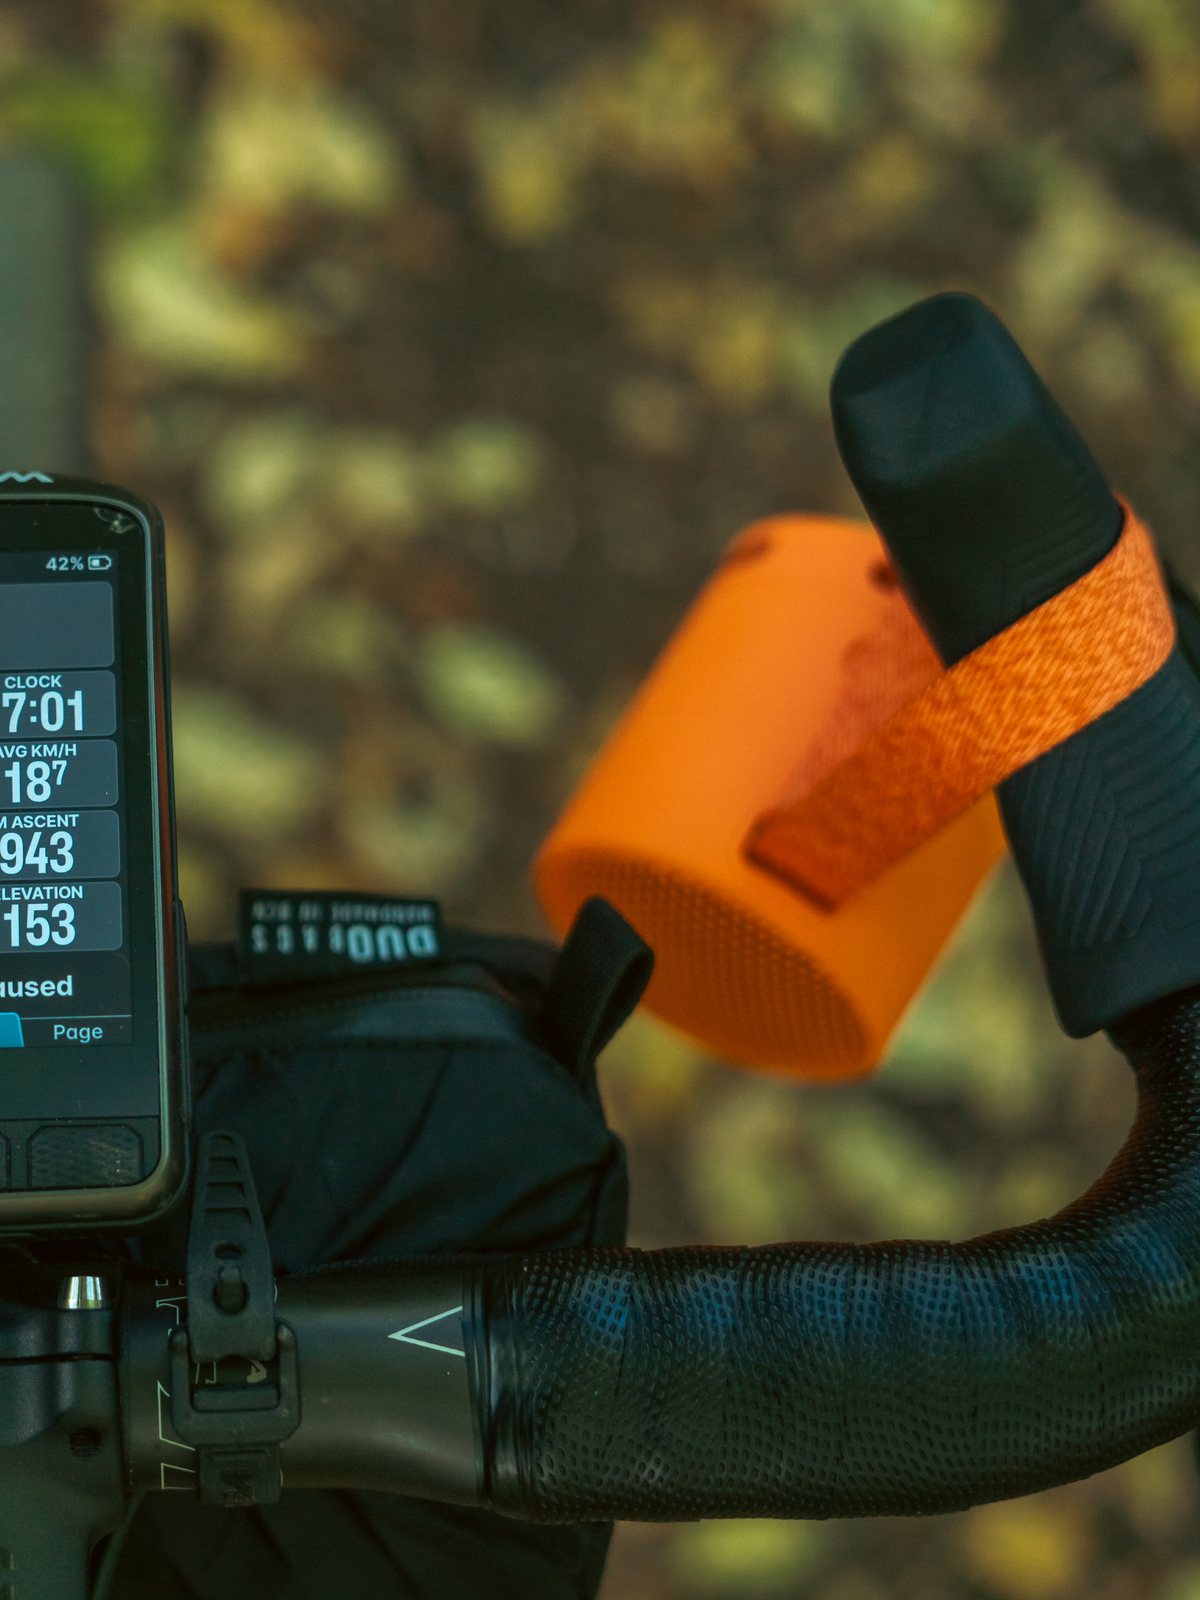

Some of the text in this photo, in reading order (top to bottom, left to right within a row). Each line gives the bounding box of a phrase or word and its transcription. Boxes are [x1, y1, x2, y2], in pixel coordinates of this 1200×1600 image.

[46, 557, 83, 570] 42%
[5, 675, 61, 689] CLOCK
[32, 744, 77, 758] KM/H
[11, 814, 79, 828] ASCENT
[0, 831, 73, 874] 943
[4, 903, 75, 946] 153
[54, 1025, 102, 1043] Page
